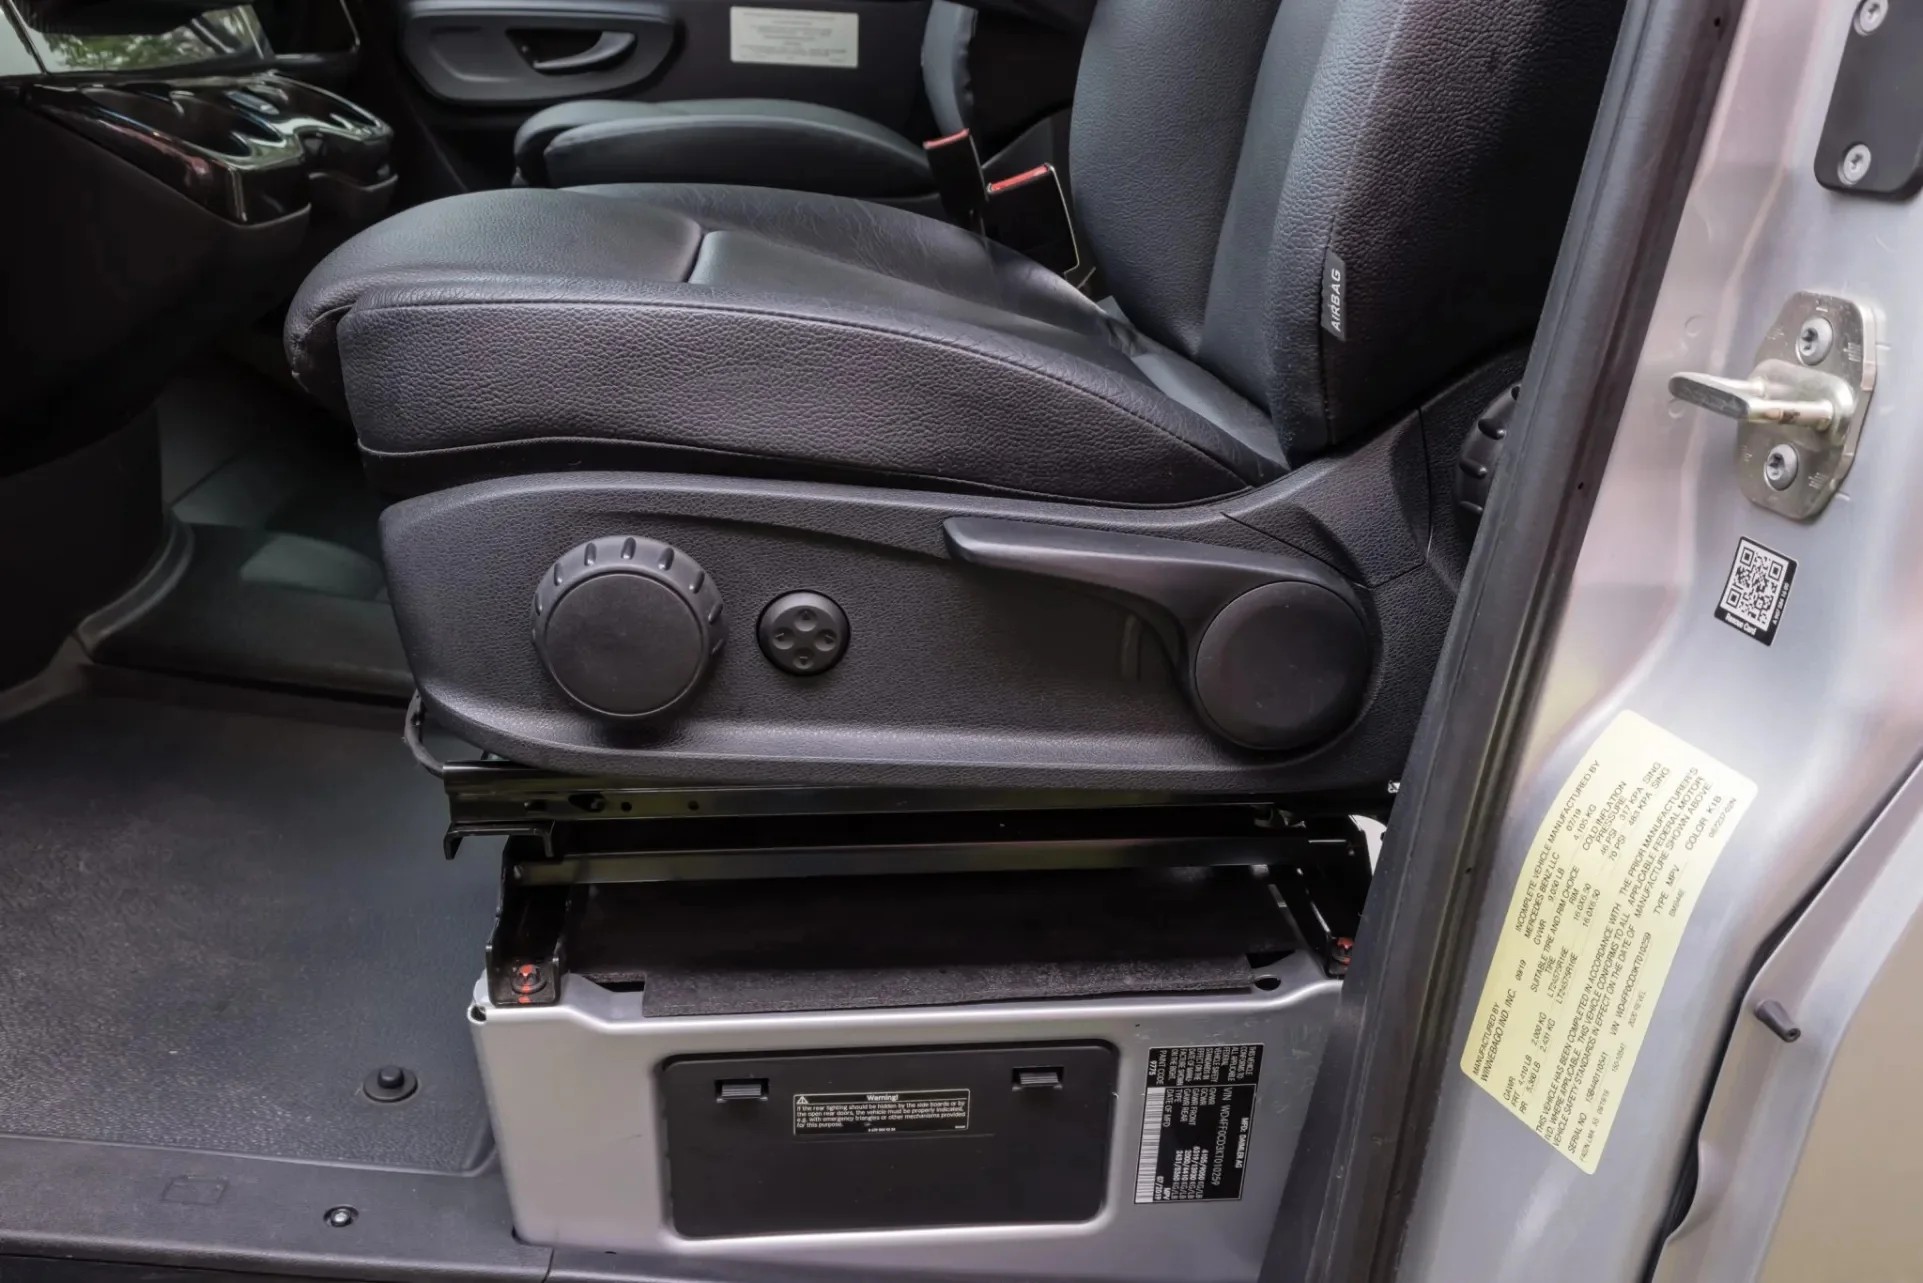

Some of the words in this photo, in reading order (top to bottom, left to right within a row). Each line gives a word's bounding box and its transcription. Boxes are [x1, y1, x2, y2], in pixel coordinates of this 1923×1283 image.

[1331, 268, 1341, 332] AIRBAG
[1641, 761, 1661, 784] SING
[1627, 785, 1644, 805] KPA
[1641, 766, 1698, 849] MANUFACTURER'S
[1676, 775, 1704, 810] MOTOR
[1581, 824, 1599, 852] COLD
[1594, 780, 1627, 826] INFLATION
[1594, 795, 1626, 844] PRESSURE
[1608, 849, 1618, 862] 70
[1613, 833, 1626, 851] PSI
[1636, 790, 1652, 810] KPA
[1650, 766, 1670, 789] SING
[1514, 879, 1537, 933] INCOMPLETE
[1532, 843, 1552, 880] VEHICLE
[1547, 772, 1592, 844] MANUFACTURED
[1587, 760, 1600, 773] BY
[1604, 827, 1618, 845] PSI
[1651, 811, 1680, 852] FEDERAL
[1664, 813, 1690, 850] SHOWN
[1683, 815, 1708, 851] COLOR
[1599, 843, 1610, 856] 46
[1627, 847, 1646, 878] PRIOR
[1533, 918, 1547, 946] GVWR
[1555, 866, 1565, 880] LB
[1584, 803, 1597, 819] KG
[1618, 876, 1632, 896] THE
[1626, 851, 1656, 906] APPLICABLE
[1633, 849, 1669, 918] MANUFACTURE
[1653, 890, 1668, 915] TYPE
[1664, 864, 1680, 887] MPV
[1524, 892, 1544, 939] MERCEDES
[1539, 868, 1553, 894] BENZ
[1547, 851, 1560, 870] LLC
[1568, 887, 1579, 905] RIM
[1530, 952, 1547, 993] SUITABLE
[1542, 933, 1554, 953] TIRE
[1548, 914, 1561, 935] AND
[1555, 897, 1567, 916] RIM
[1561, 865, 1580, 899] CHOICE
[1608, 901, 1622, 926] WITH
[1618, 910, 1630, 928] ALL
[1613, 926, 1624, 941] TO
[1625, 924, 1636, 939] OF
[1544, 955, 1556, 974] TIRE
[1587, 925, 1613, 984] ACCORDANCE
[1596, 940, 1618, 990] CONFORMS
[1617, 937, 1631, 963] DATE
[1605, 978, 1616, 995] ON
[1610, 961, 1622, 980] THE
[1584, 982, 1592, 994] IN
[1566, 992, 1589, 1044] COMPLETED
[1583, 989, 1601, 1025] VEHICLE
[1594, 994, 1611, 1027] EFFECT
[1472, 1012, 1496, 1076] MANUFACTURED
[1491, 1001, 1500, 1015] BY
[1523, 1053, 1532, 1067] LB
[1536, 1010, 1546, 1026] KG
[1577, 1023, 1589, 1044] THIS
[1590, 1025, 1600, 1037] IN
[1608, 1019, 1620, 1036] VIN
[1480, 1025, 1504, 1083] WINNEBAGO
[1532, 1059, 1541, 1074] LB
[1545, 1016, 1555, 1032] KG
[1559, 1041, 1571, 1066] BEEN
[1574, 1034, 1596, 1085] STANDARDS
[1148, 1060, 1157, 1075] 9775
[1553, 1064, 1564, 1084] HAS
[867, 1094, 898, 1102] Warning!
[1222, 1087, 1232, 1100] VIN
[1542, 1081, 1558, 1116] VEHICLE
[1549, 1094, 1564, 1125] WHERE
[1563, 1083, 1579, 1115] SAFETY
[1535, 1114, 1547, 1134] THIS
[1552, 1113, 1568, 1148] VEHICLE
[1567, 1124, 1582, 1154] SERIAL
[1576, 1110, 1587, 1127] NO
